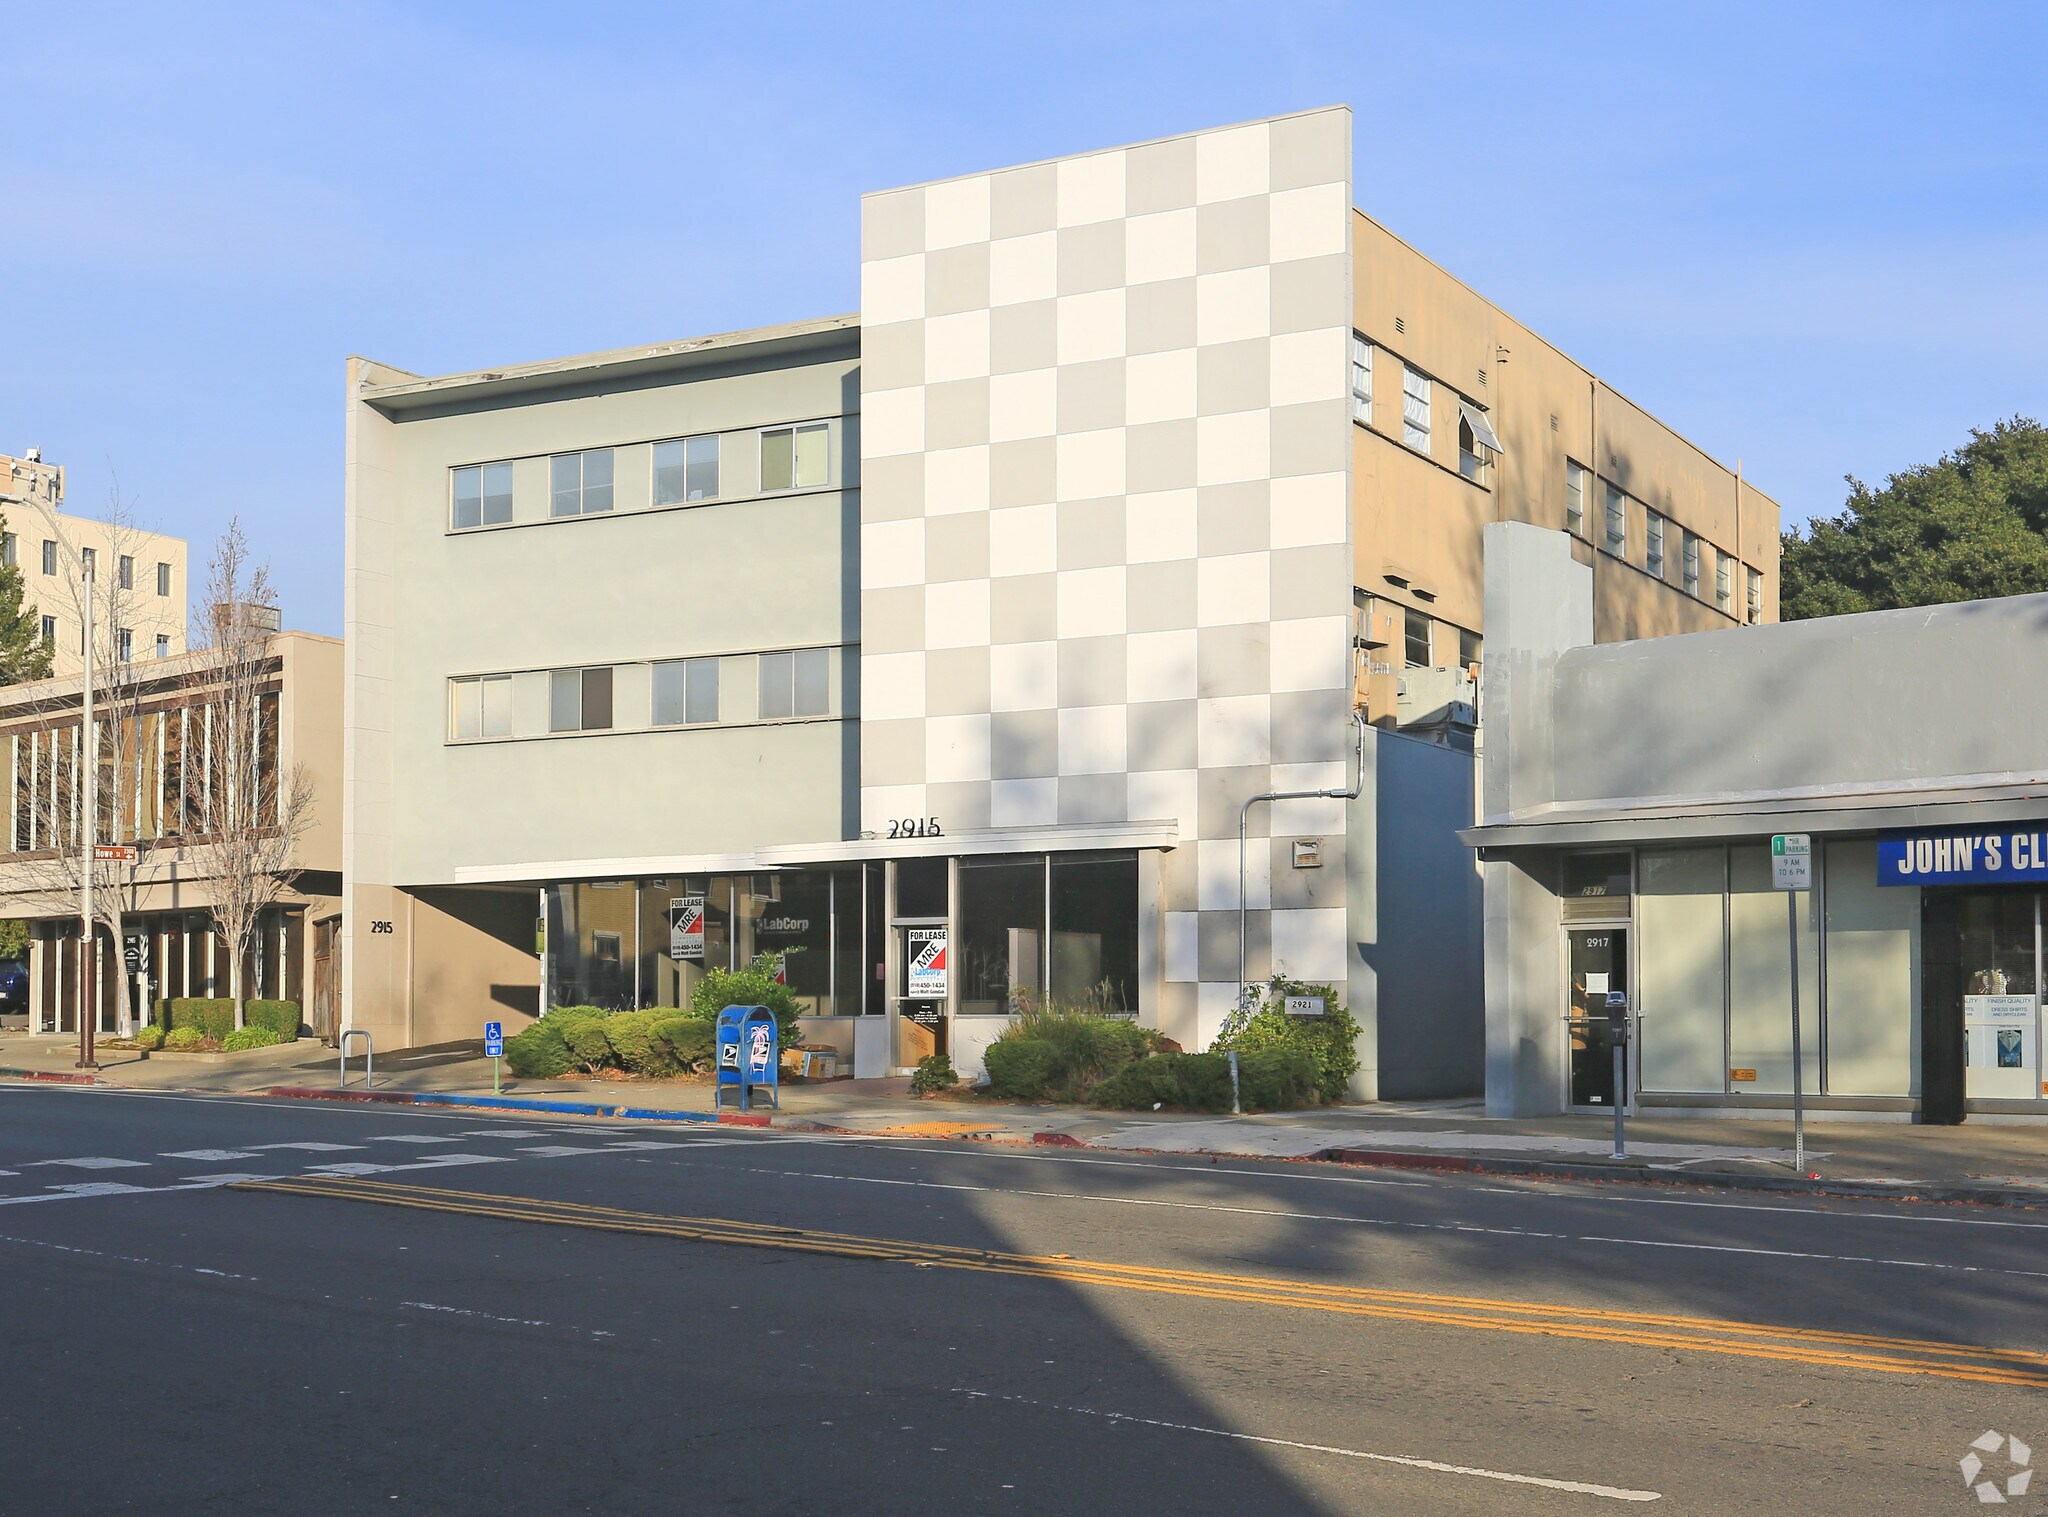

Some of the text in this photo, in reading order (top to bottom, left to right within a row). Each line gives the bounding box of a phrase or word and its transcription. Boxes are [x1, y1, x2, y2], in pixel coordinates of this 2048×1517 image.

[888, 817, 940, 838] 2915
[95, 848, 114, 858] Howe
[1785, 845, 1808, 853] PARKING
[1898, 833, 2048, 874] JOHN'S CL
[1779, 868, 1787, 876] TO
[1789, 868, 1794, 876] 6
[1583, 886, 1606, 896] 2917
[671, 898, 703, 907] FOR LEASE
[677, 908, 697, 934] MRE
[763, 917, 809, 932] LabCorp
[370, 920, 393, 934] 2915
[910, 931, 947, 940] FOR LEASE
[1586, 937, 1609, 948] 2917
[917, 942, 939, 969] MRE
[915, 967, 941, 977] LabCorp
[1292, 1000, 1312, 1009] 2921
